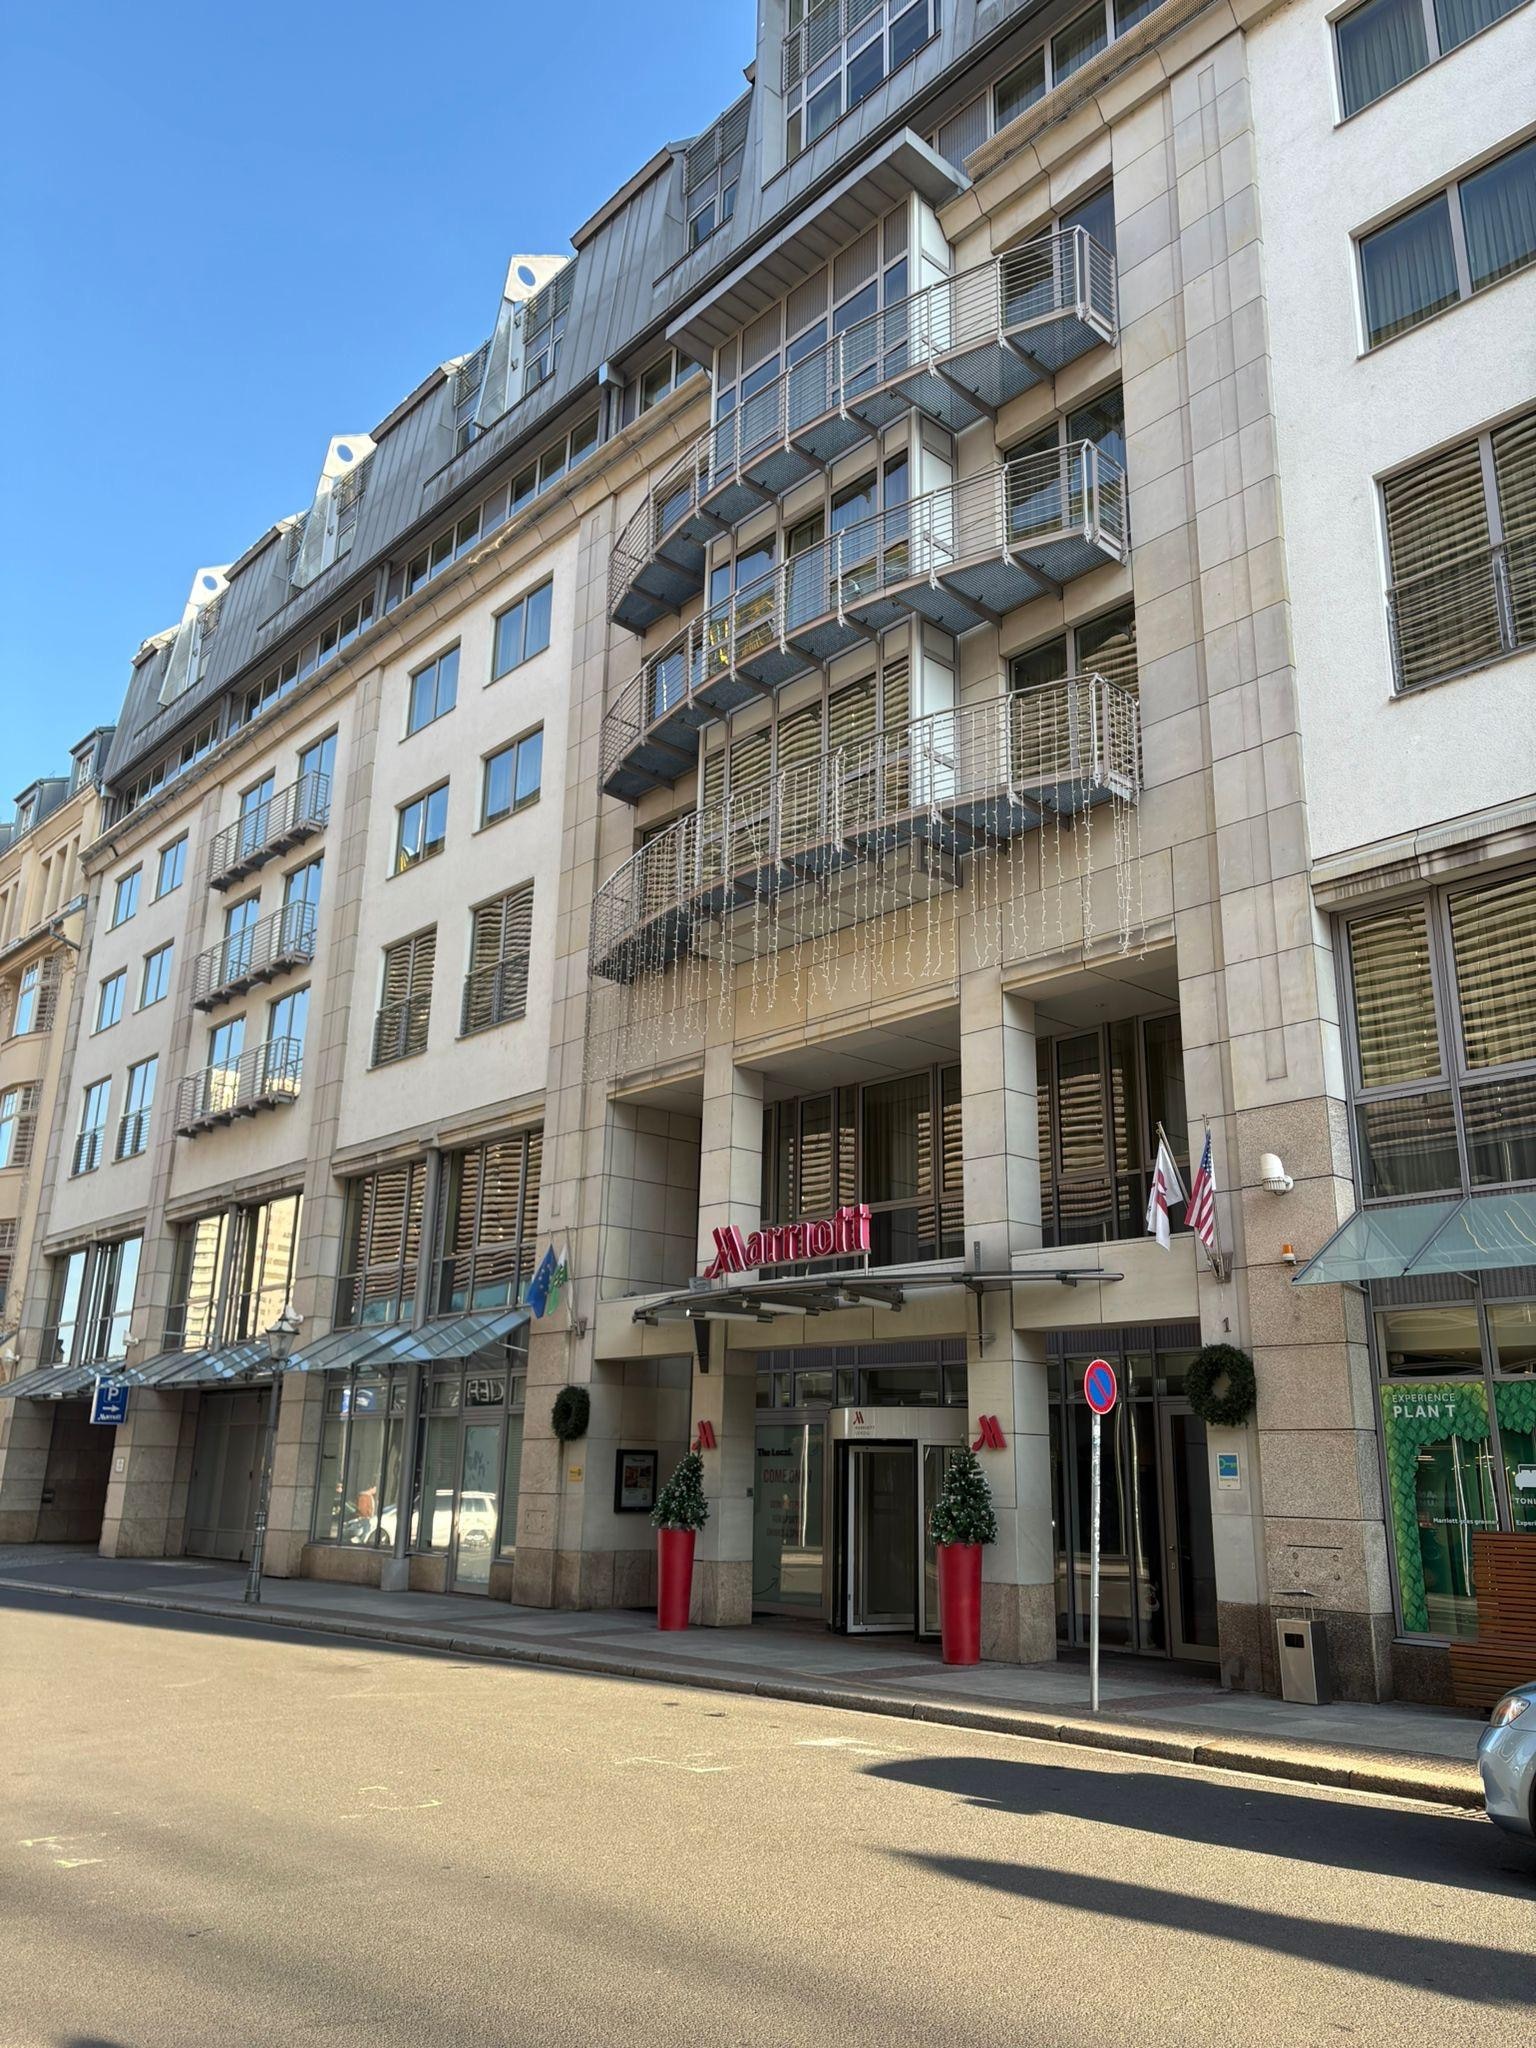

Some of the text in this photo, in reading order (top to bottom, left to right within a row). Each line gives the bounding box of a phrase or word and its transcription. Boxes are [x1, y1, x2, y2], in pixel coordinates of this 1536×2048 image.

[703, 1203, 872, 1279] Marriott
[1222, 1316, 1232, 1333] 1
[107, 1387, 119, 1401] P
[1392, 1393, 1456, 1403] EXPERIENCE
[1393, 1404, 1456, 1418] PLAN T
[757, 1448, 770, 1456] The
[763, 1469, 789, 1483] COME
